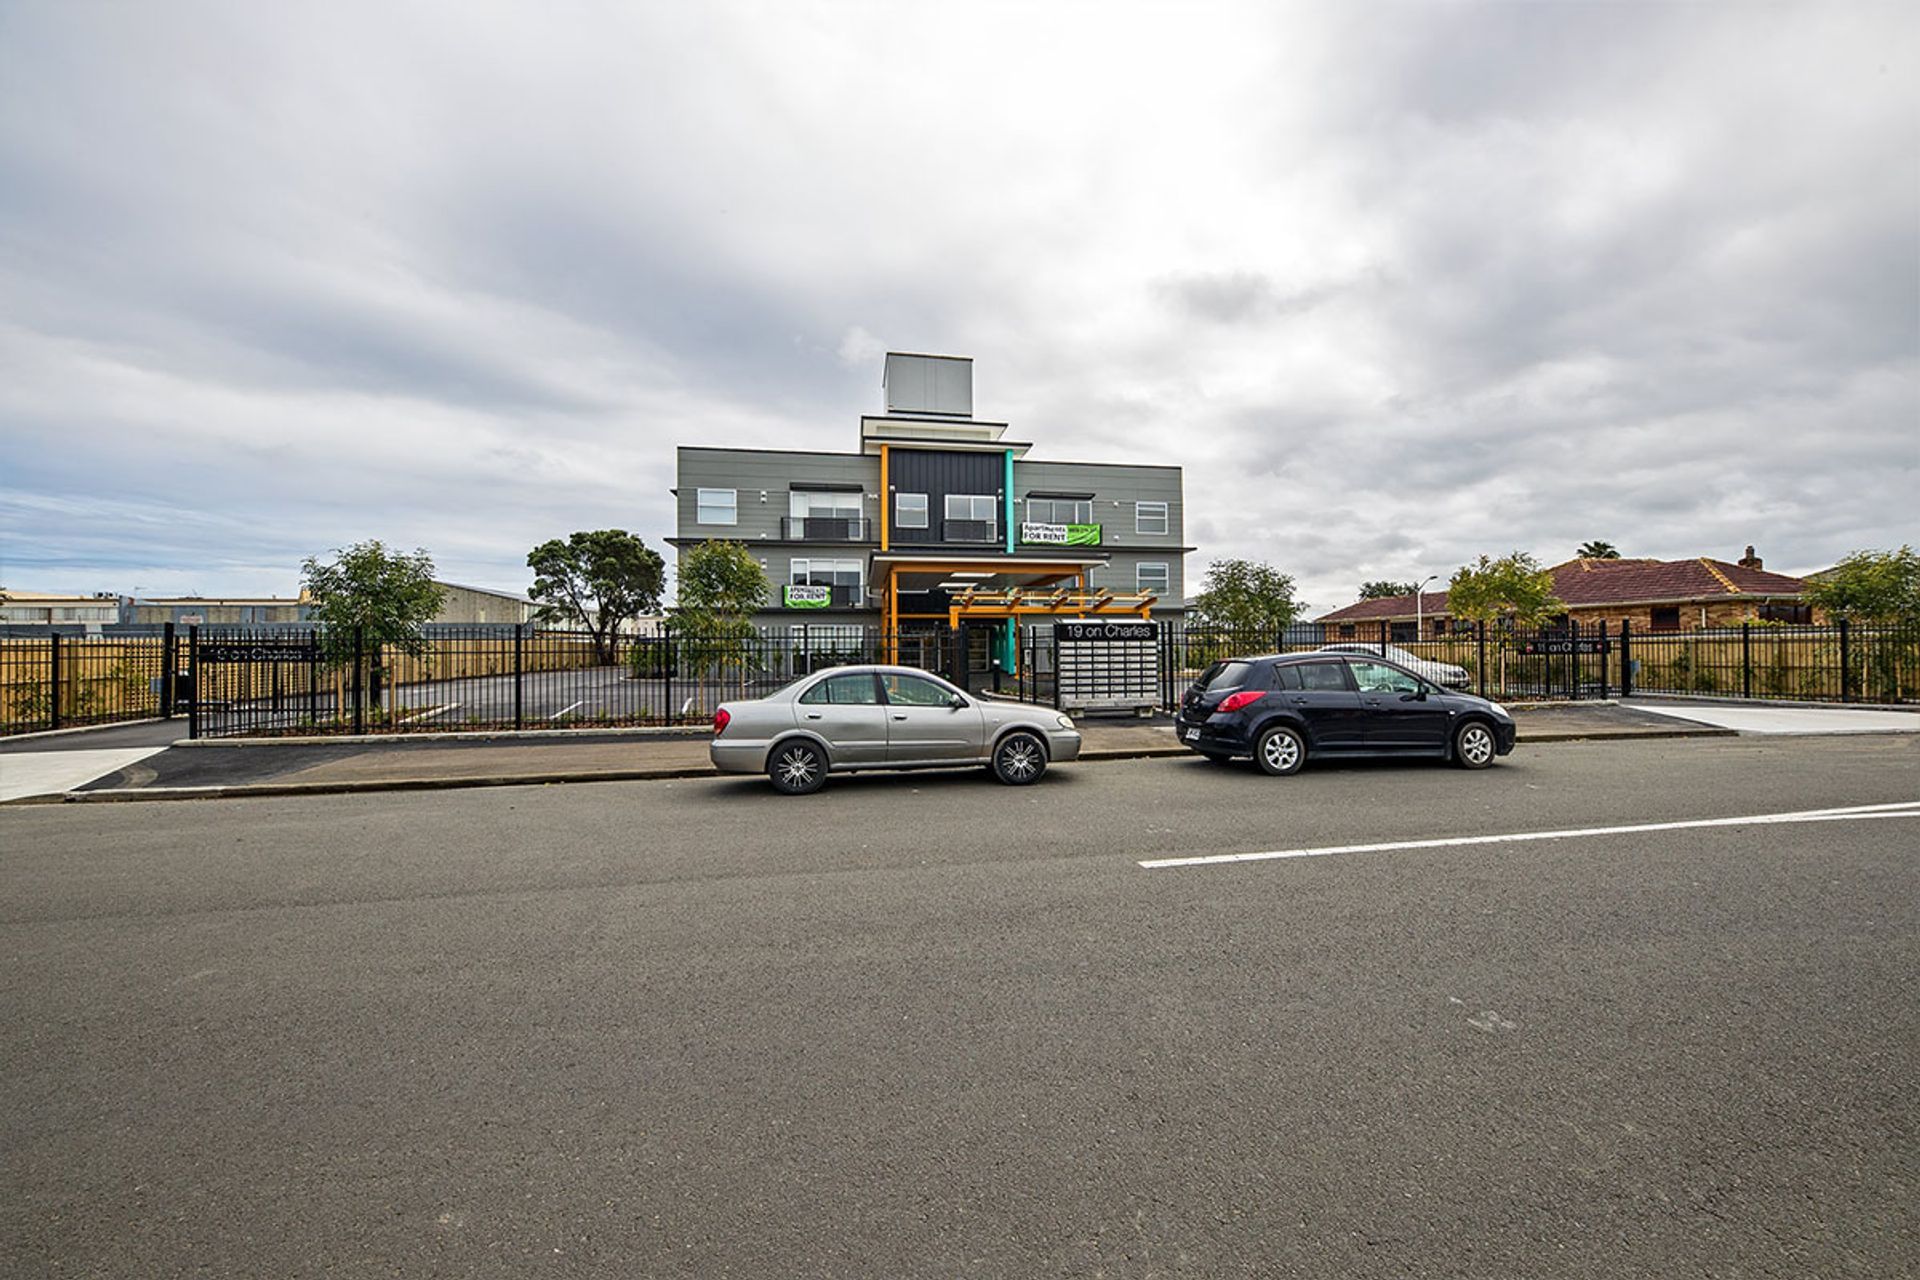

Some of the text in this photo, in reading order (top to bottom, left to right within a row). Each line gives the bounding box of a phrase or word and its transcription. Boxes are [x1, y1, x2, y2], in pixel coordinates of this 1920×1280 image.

[1068, 624, 1150, 637] 19 on Charles
